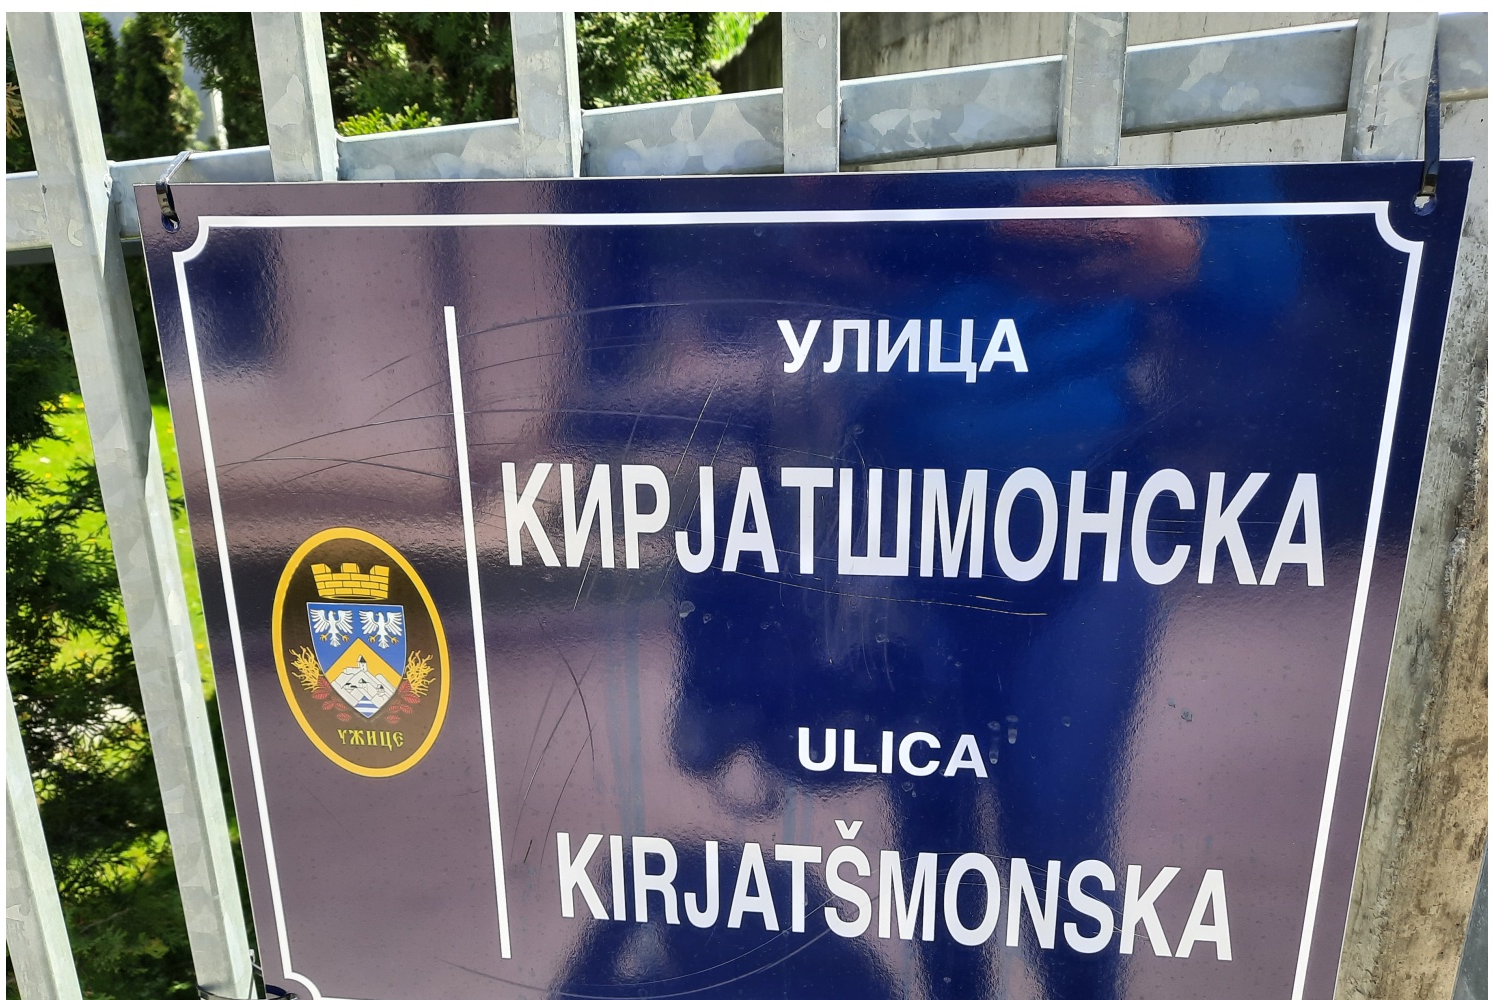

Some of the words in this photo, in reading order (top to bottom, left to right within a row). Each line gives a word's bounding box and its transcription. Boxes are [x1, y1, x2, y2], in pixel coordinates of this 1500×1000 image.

[776, 318, 1029, 383] УЛИЦА
[501, 462, 1325, 587] КИРЈАТШМОНСКА
[337, 728, 405, 752] УЖИЦЕ
[798, 726, 988, 778] ULICA
[556, 820, 1233, 961] KIRJATŠMONSKA
